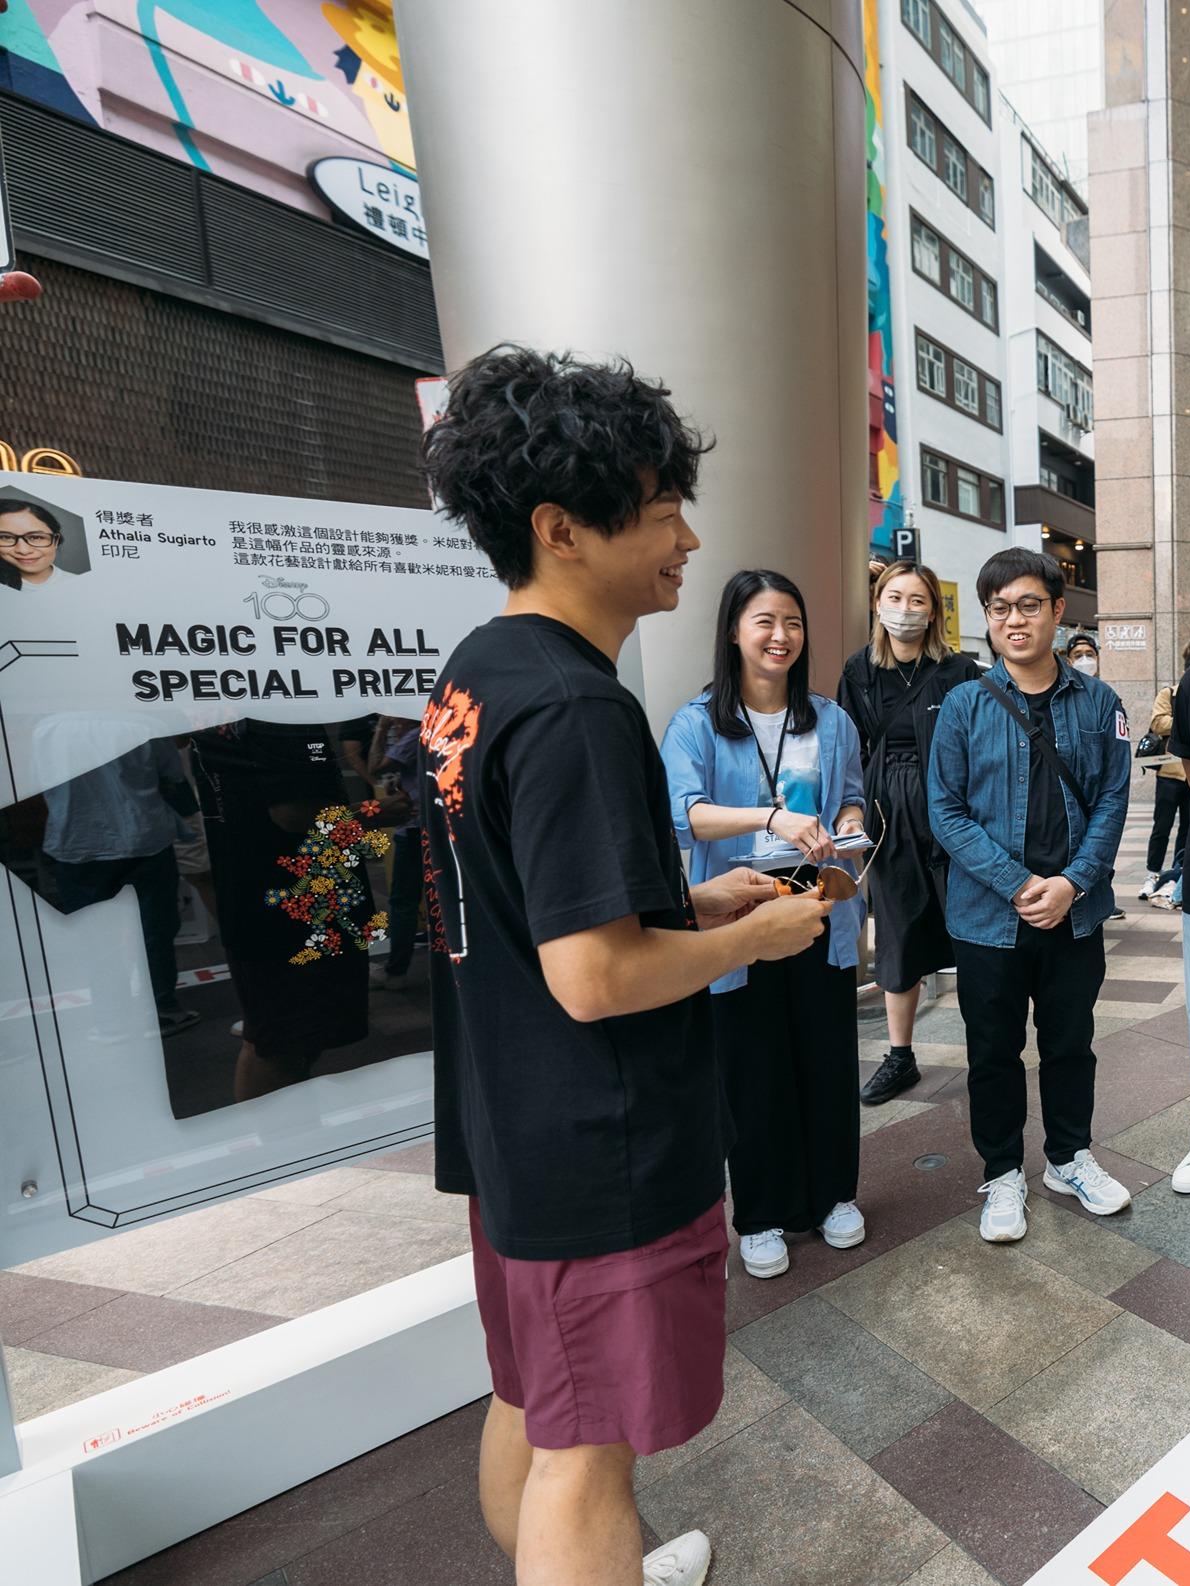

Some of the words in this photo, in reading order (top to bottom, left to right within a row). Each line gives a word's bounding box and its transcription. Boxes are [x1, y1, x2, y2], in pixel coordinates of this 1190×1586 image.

[95, 510, 154, 527] 得獎者
[99, 528, 152, 543] Athalia
[157, 532, 216, 547] Sugiarto
[896, 530, 913, 556] P
[101, 544, 140, 560] 印尼
[243, 591, 330, 622] 100
[115, 622, 257, 656] MAGIC
[273, 625, 352, 656] FOR
[366, 627, 441, 656] ALL
[131, 669, 319, 702] SPECIAL
[332, 668, 437, 698] PRIZE
